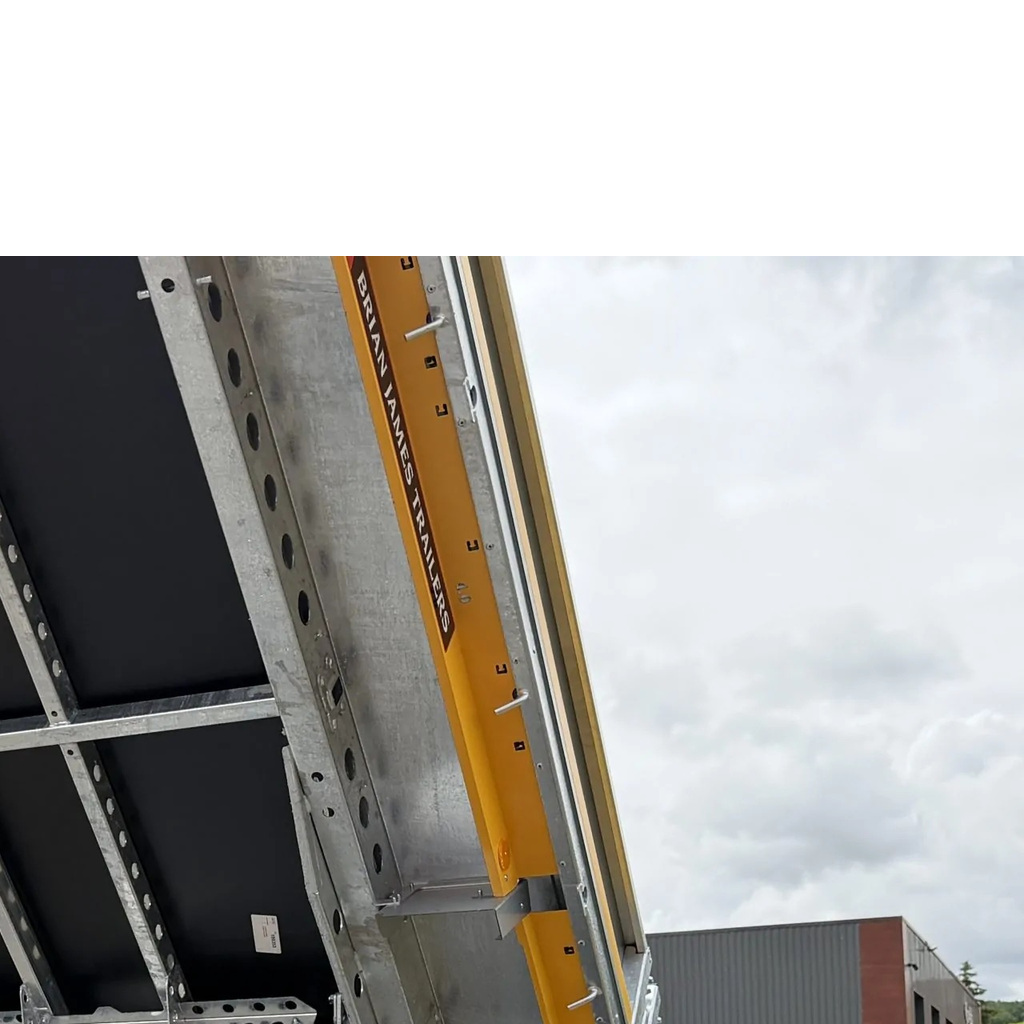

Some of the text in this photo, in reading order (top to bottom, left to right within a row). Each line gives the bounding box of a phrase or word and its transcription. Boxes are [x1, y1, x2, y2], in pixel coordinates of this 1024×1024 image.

[357, 269, 451, 634] BRIAN JAMES TRAILERS
